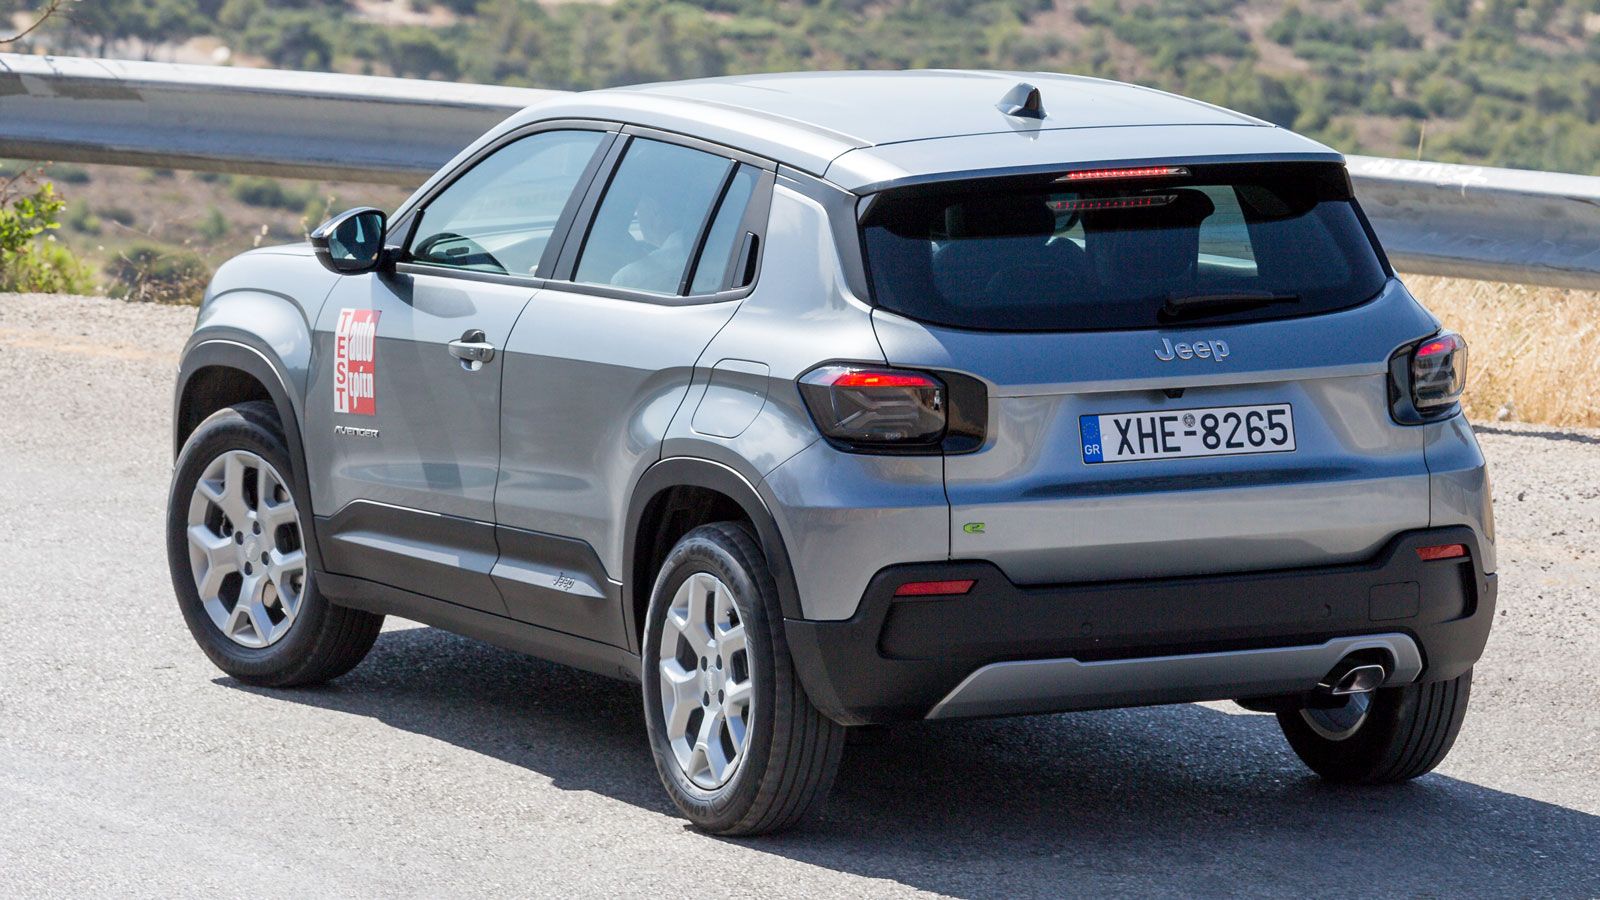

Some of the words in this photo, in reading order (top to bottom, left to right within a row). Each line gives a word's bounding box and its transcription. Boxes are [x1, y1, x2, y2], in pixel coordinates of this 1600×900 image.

[1154, 337, 1230, 362] Jeep
[336, 311, 352, 410] TEST
[334, 425, 379, 438] AVENGER
[1084, 444, 1100, 455] GR
[552, 571, 575, 591] Jeep
